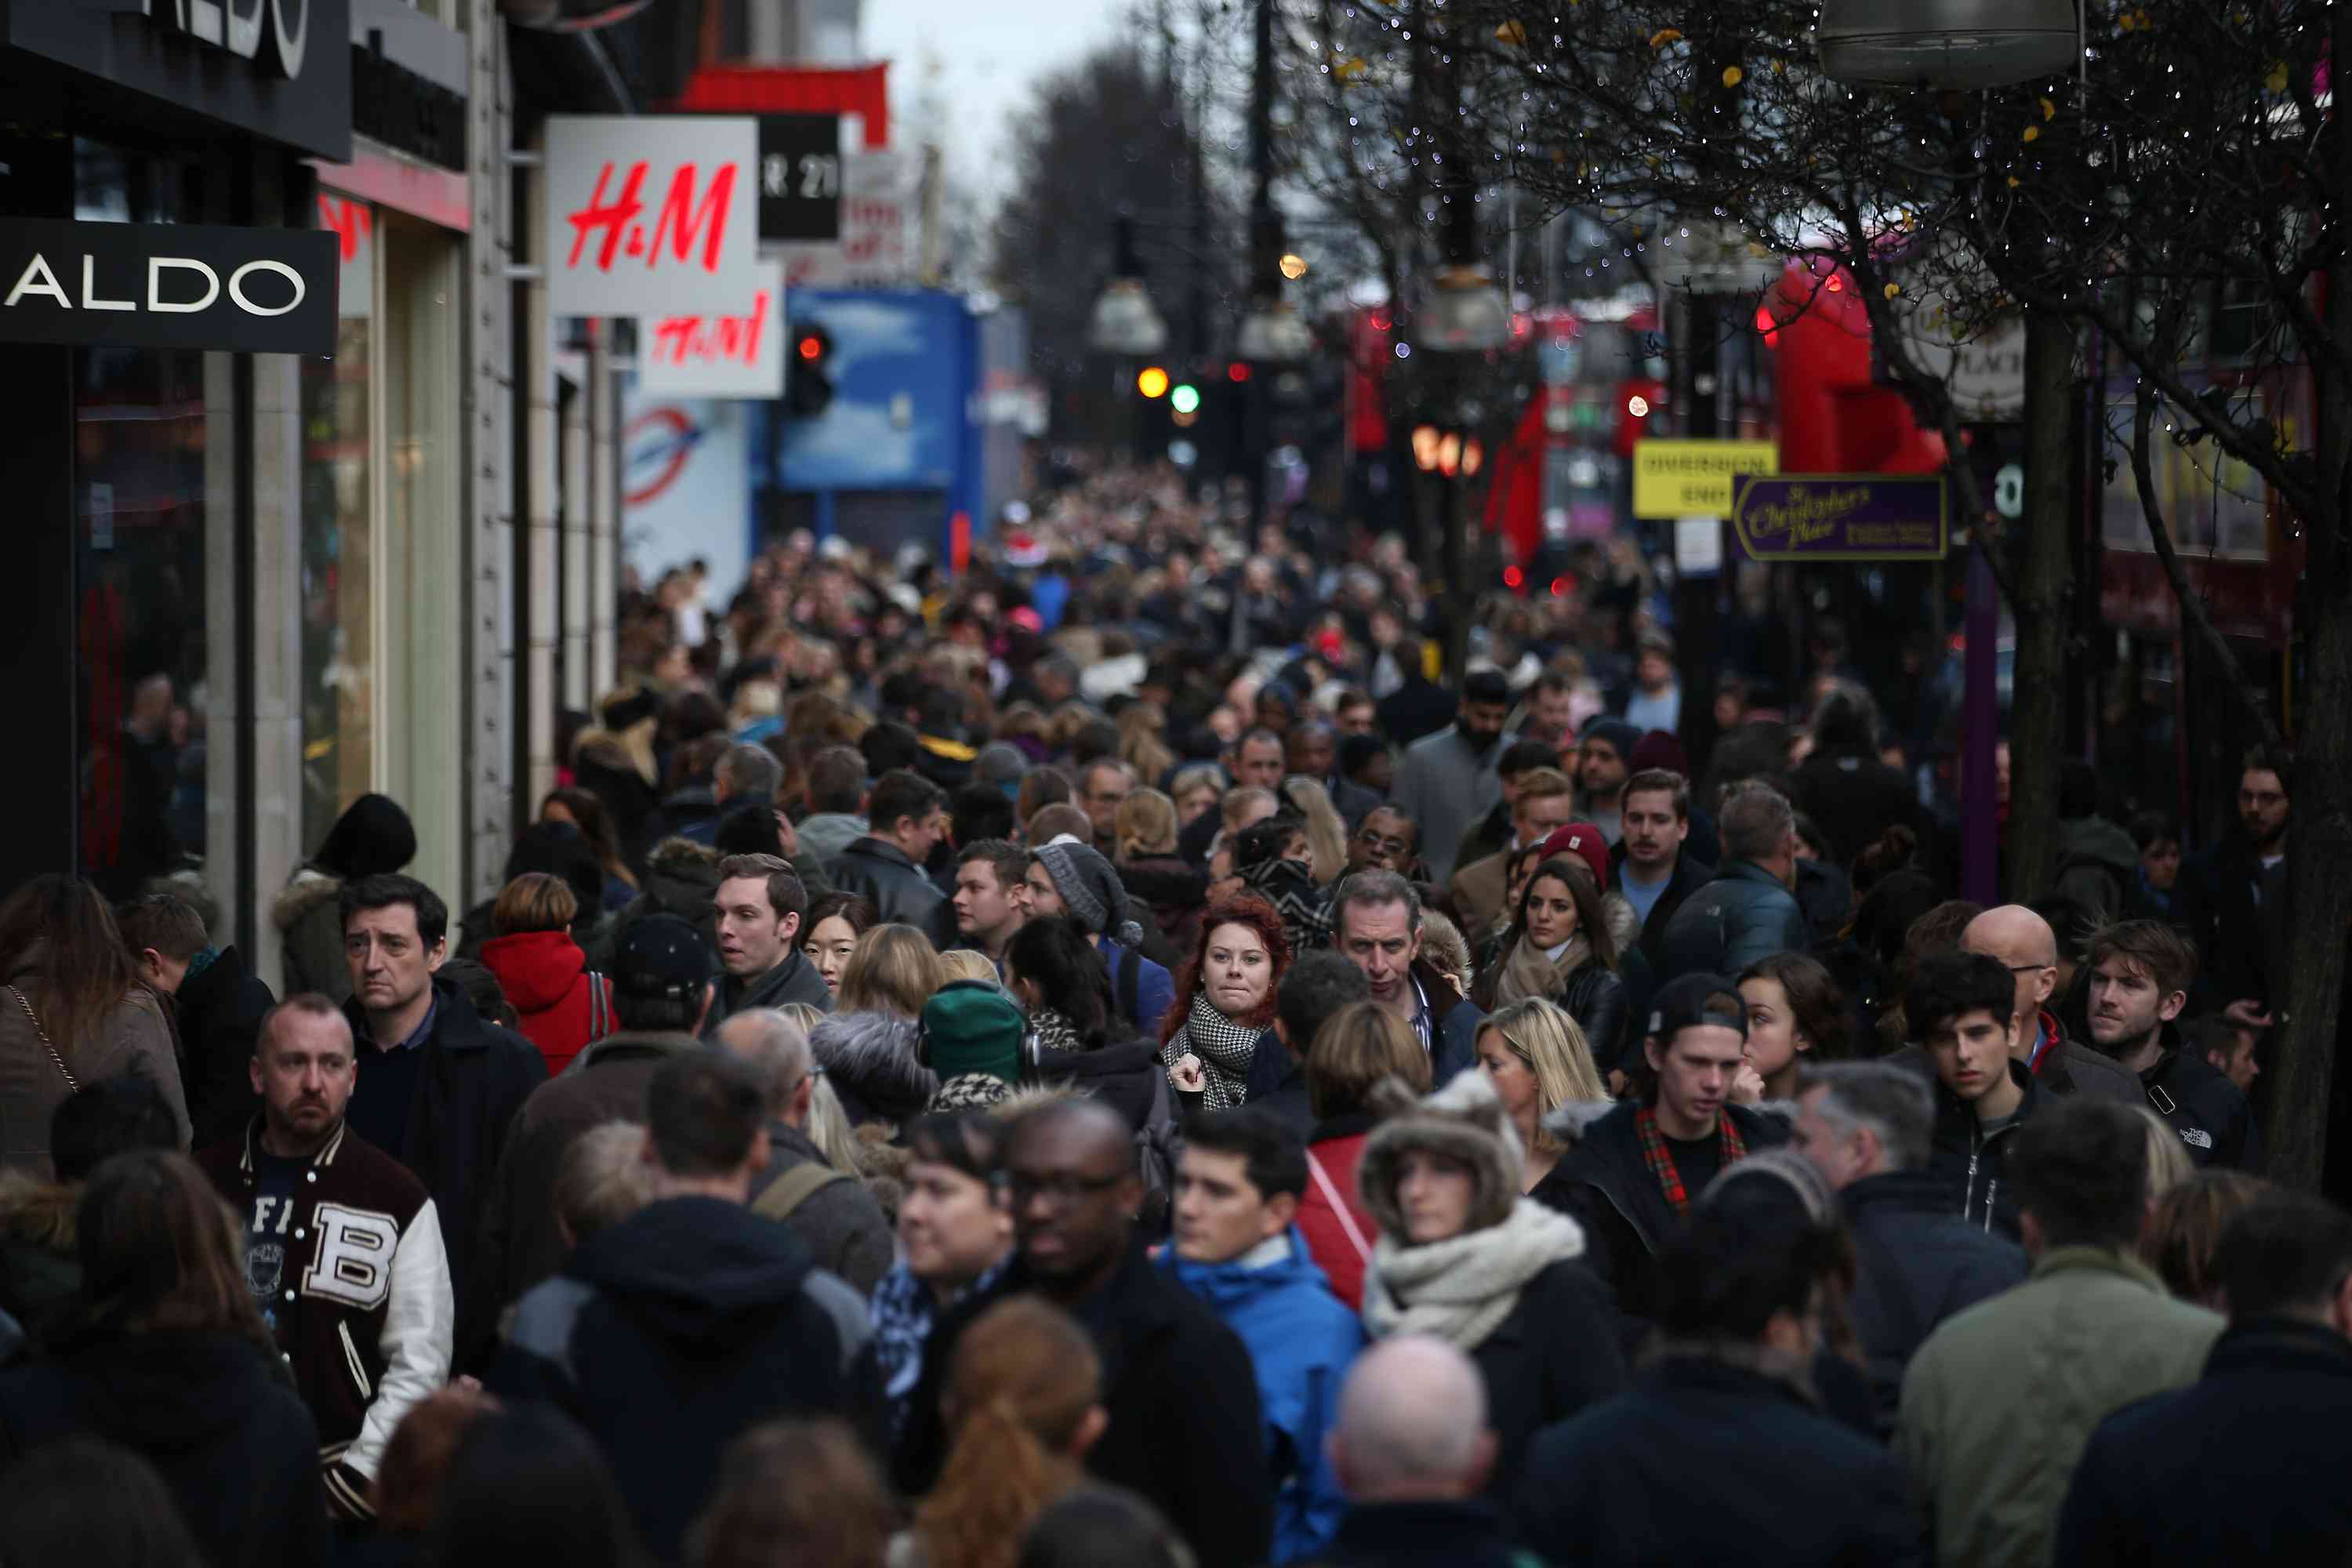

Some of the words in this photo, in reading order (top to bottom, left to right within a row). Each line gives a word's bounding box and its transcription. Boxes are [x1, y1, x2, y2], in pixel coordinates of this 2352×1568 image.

[798, 154, 839, 198] 21
[566, 160, 739, 273] H&M
[3, 252, 307, 317] ALDO
[1642, 453, 1766, 475] DIVERSION
[1681, 484, 1727, 506] END
[301, 1201, 400, 1312] B
